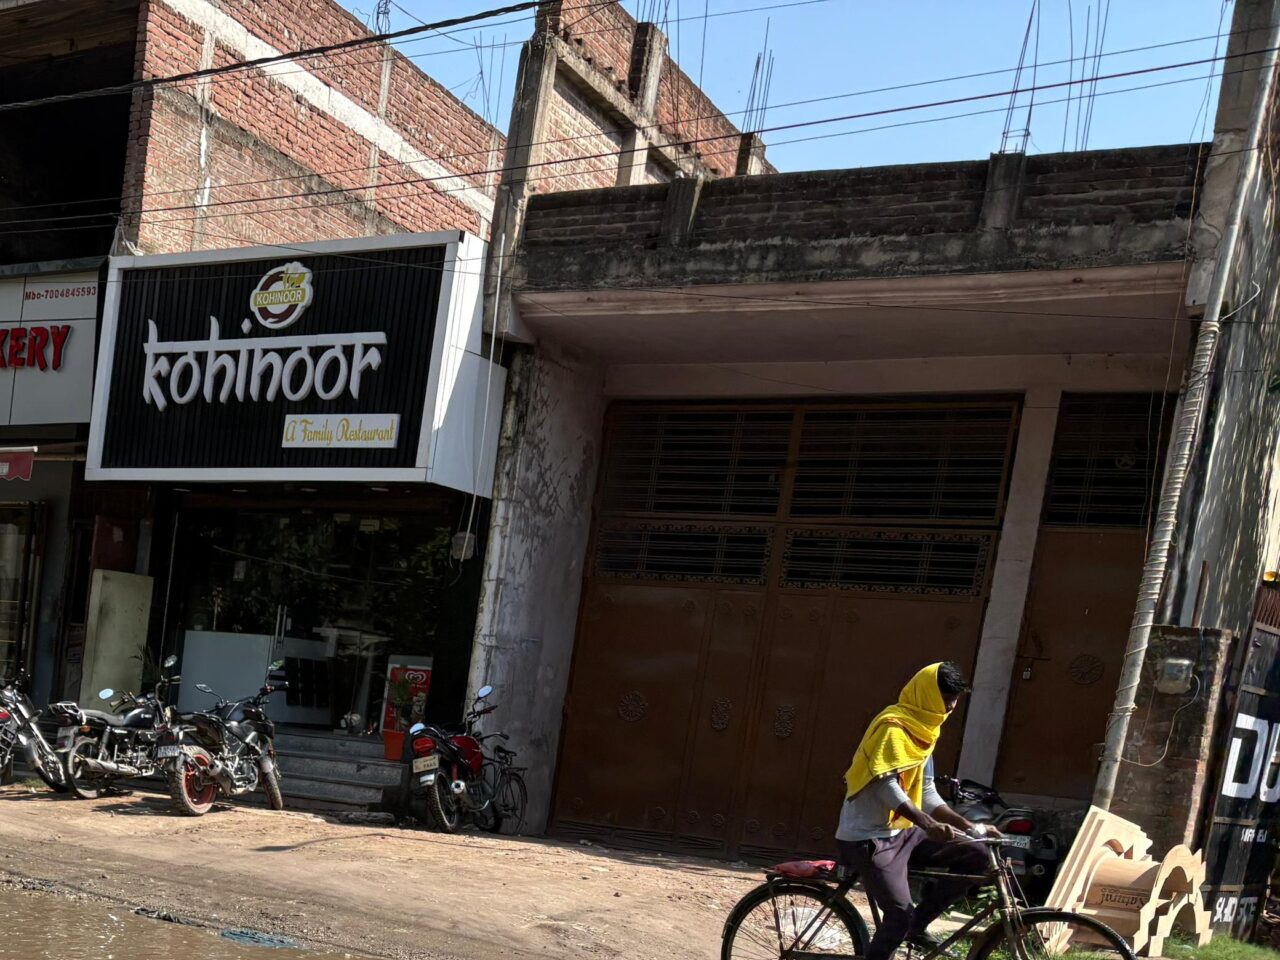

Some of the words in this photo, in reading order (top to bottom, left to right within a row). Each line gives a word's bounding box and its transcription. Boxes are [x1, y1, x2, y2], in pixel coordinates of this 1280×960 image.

[256, 289, 303, 305] KOHINOOR
[300, 417, 333, 446] Family
[335, 416, 395, 443] Restaurant
